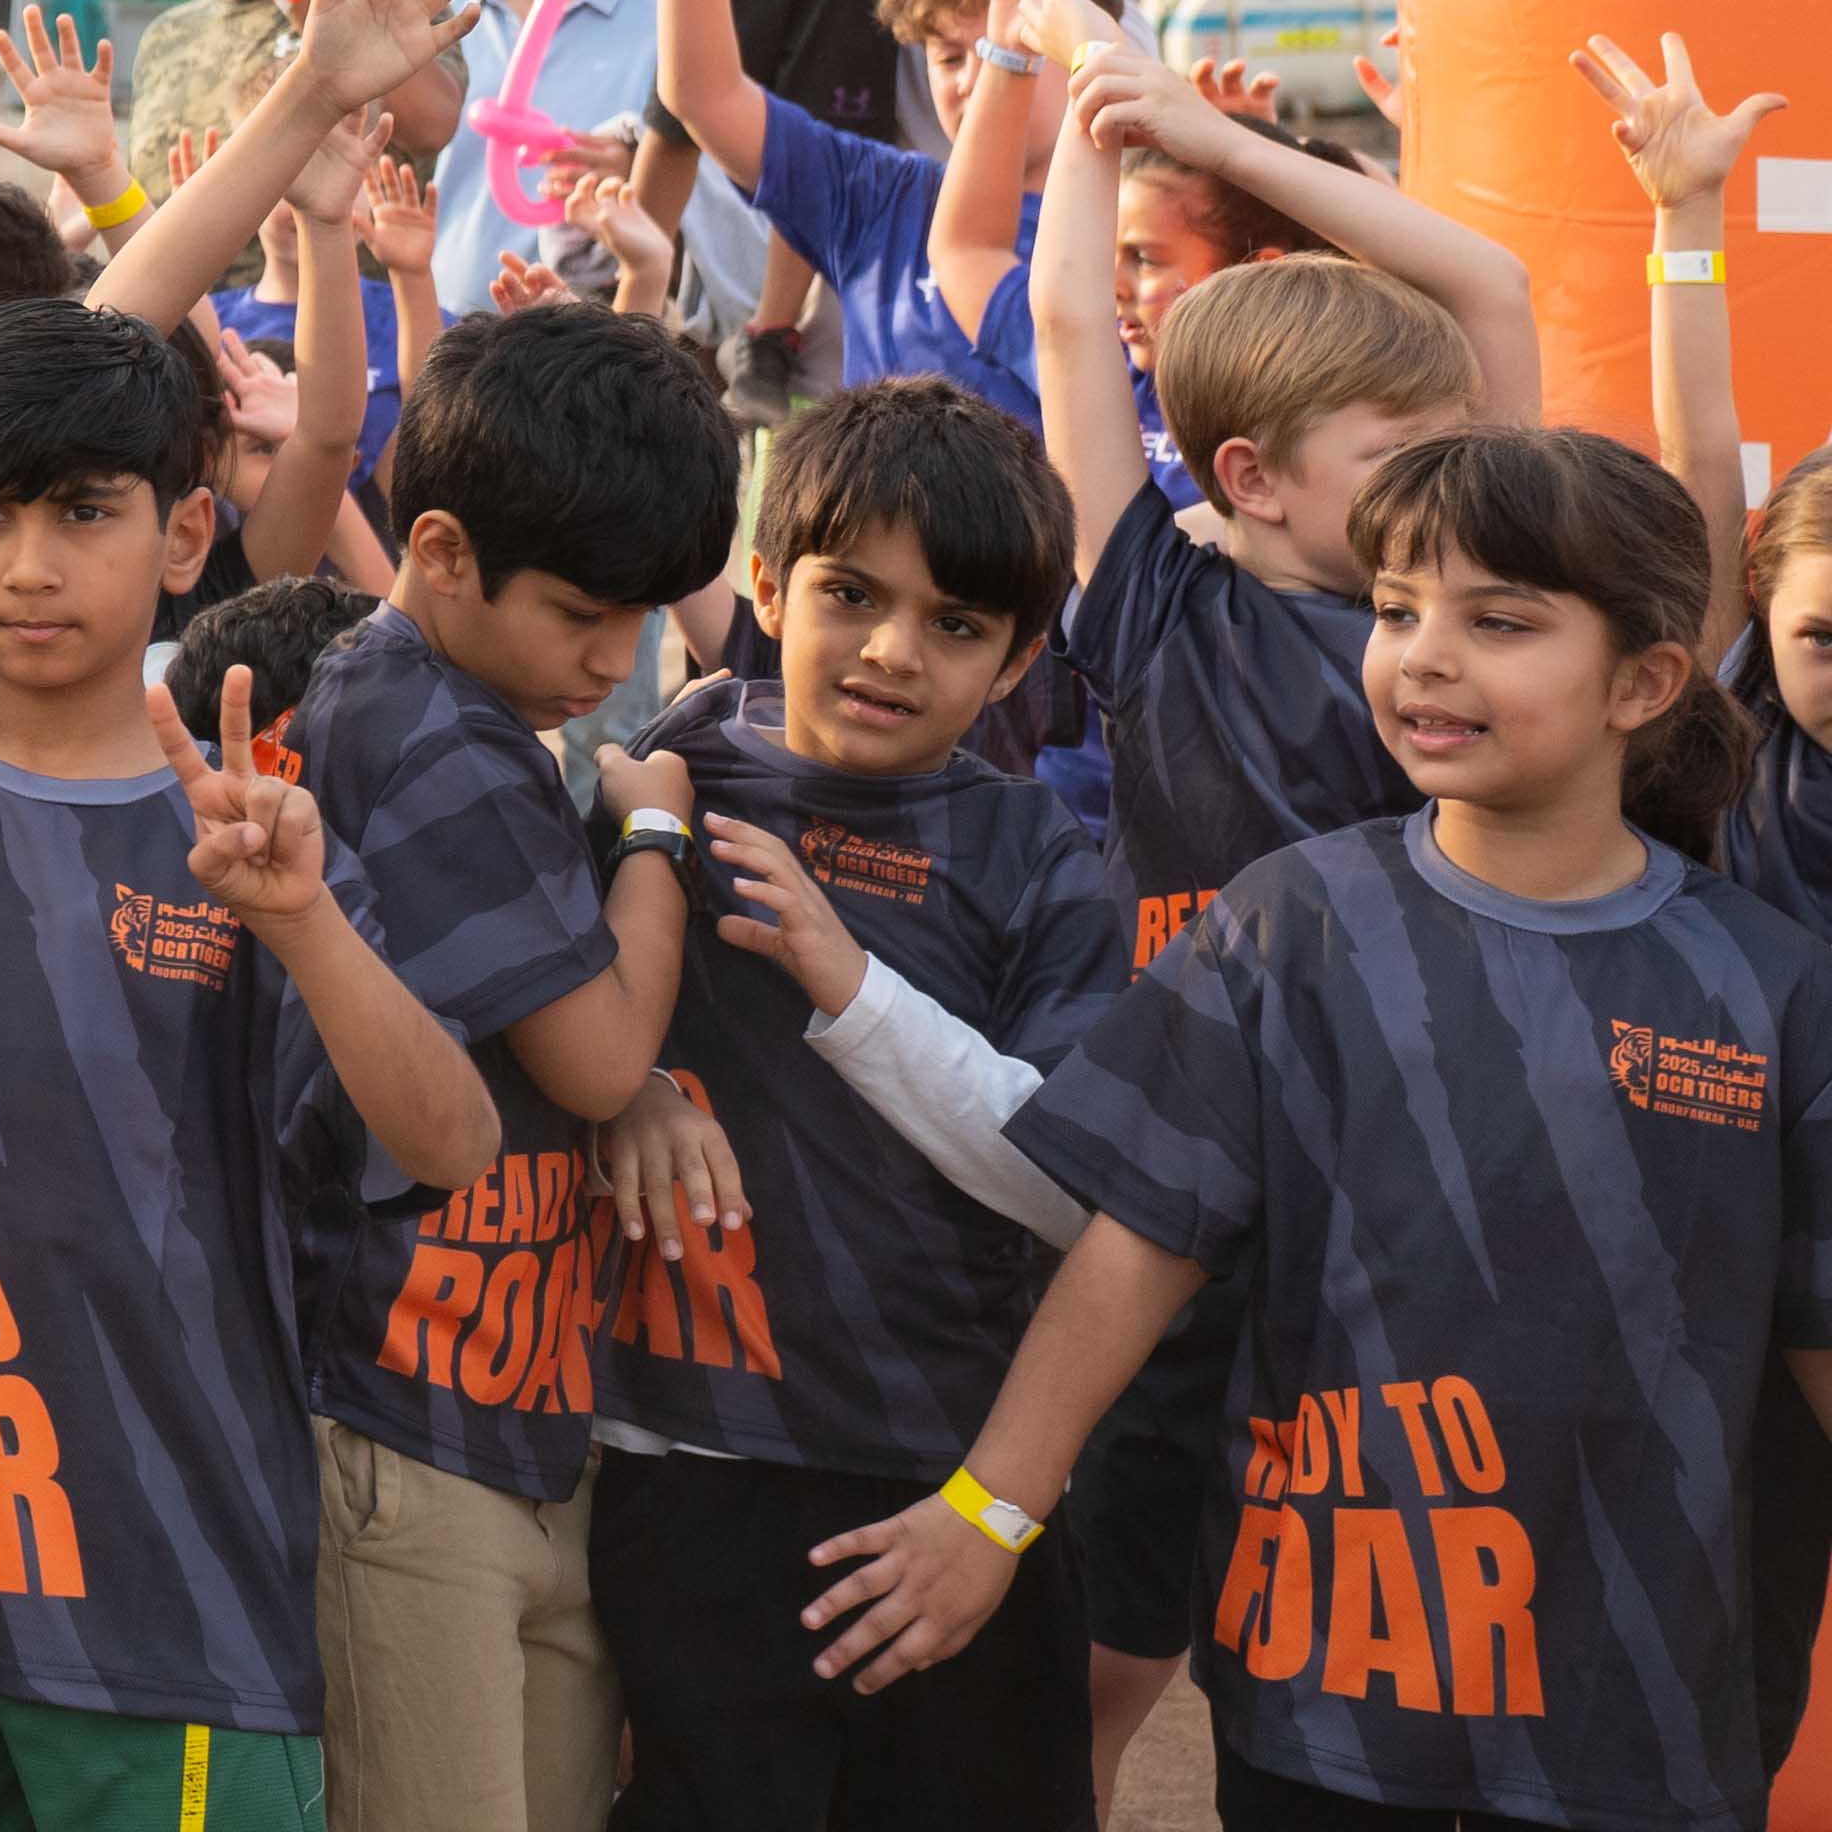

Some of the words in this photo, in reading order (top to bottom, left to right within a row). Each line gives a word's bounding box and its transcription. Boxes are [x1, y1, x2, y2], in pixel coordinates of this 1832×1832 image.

[154, 920, 194, 940] 2025
[151, 939, 187, 960] OCR
[1657, 1053, 1701, 1077] 2025
[1655, 1072, 1695, 1097] OCR
[1698, 1080, 1764, 1110] TIGERS
[1380, 1374, 1507, 1498] TO
